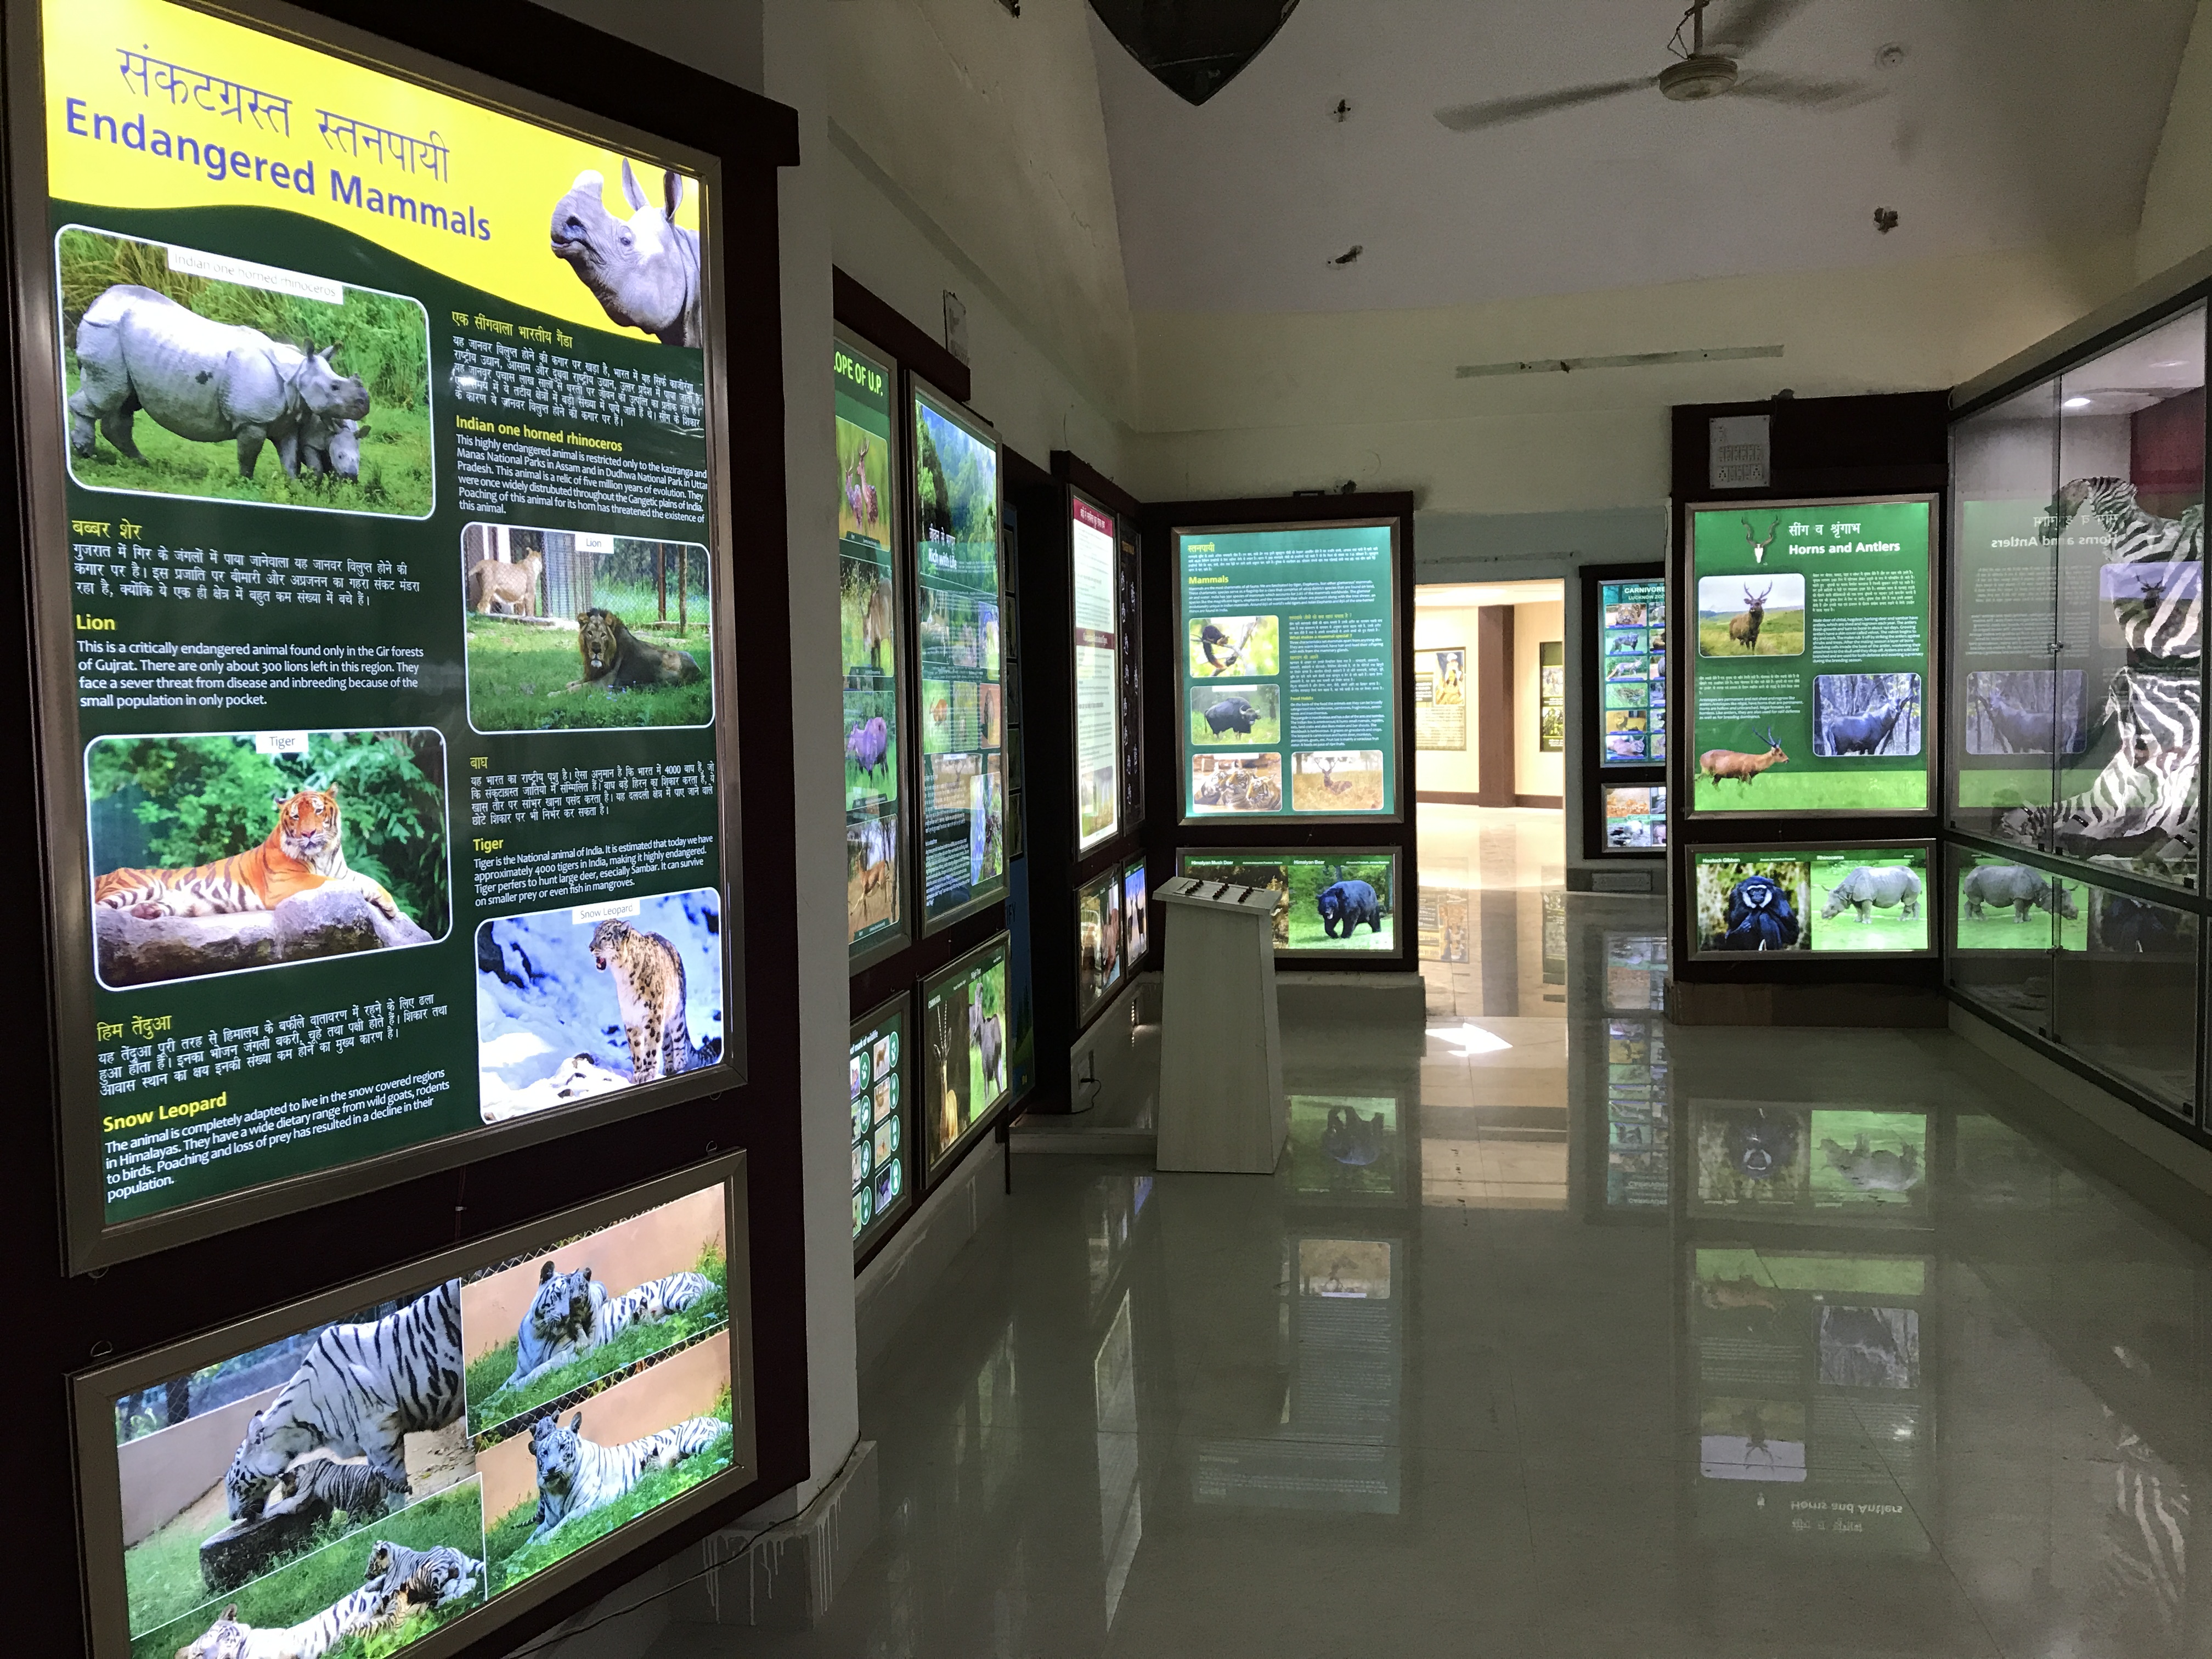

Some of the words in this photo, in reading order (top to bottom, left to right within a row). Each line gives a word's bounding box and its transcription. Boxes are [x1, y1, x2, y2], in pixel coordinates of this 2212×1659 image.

[116, 44, 292, 138] संकटग्रस्त
[315, 109, 450, 183] स्तनपायी
[66, 97, 315, 195] Endangered
[331, 169, 492, 241] Mammals
[175, 253, 210, 270] Indian
[213, 263, 234, 275] one
[281, 276, 336, 297] rhinoceros
[452, 311, 469, 327] एक
[475, 314, 514, 336] सींगवाला
[518, 325, 552, 344] भारतीय
[556, 328, 573, 348] गैंडा
[834, 351, 854, 380] OPE
[855, 363, 866, 386] OF
[868, 370, 883, 396] U.P.
[456, 415, 495, 433] Indian
[498, 422, 520, 437] one
[523, 425, 563, 444] horned
[567, 432, 623, 452] rhinoceros
[456, 433, 473, 446] This
[475, 436, 501, 452] highly
[502, 442, 551, 457] endangered
[552, 448, 578, 460] animal
[578, 451, 585, 461] is
[586, 454, 622, 467] restricted
[622, 459, 639, 471] only
[639, 460, 647, 470] to
[648, 461, 661, 472] the
[661, 462, 693, 479] kaziranga
[694, 469, 707, 479] and
[72, 520, 110, 538] बब्बर
[119, 518, 142, 540] शेर
[1788, 522, 1809, 536] सींग
[1815, 524, 1824, 535] व
[586, 538, 602, 548] Lion
[1188, 542, 1215, 552] स्तनपायी
[1789, 545, 1825, 555] Horns
[1829, 542, 1852, 553] and
[1855, 541, 1900, 552] Antlers
[72, 543, 112, 561] गुजरात
[117, 543, 127, 558] में
[131, 544, 153, 560] गिर
[157, 545, 169, 561] के
[173, 548, 204, 563] जंगलों
[208, 549, 218, 564] में
[223, 554, 245, 566] पाया
[249, 552, 290, 568] जानेवाला
[294, 558, 308, 570] यह
[312, 559, 343, 572] जानवर
[347, 558, 373, 577] विलुप्त
[376, 560, 393, 574] होने
[396, 561, 408, 575] की
[928, 548, 939, 563] Rich
[1188, 575, 1229, 584] Mammals
[76, 614, 116, 631] Lion
[76, 640, 104, 653] This
[106, 640, 116, 653] is
[118, 644, 127, 653] a
[128, 641, 178, 657] critically
[180, 642, 250, 658] endangered
[252, 644, 288, 656] animal
[289, 644, 321, 656] found
[323, 645, 345, 659] only
[346, 645, 356, 656] in
[357, 645, 374, 657] the
[376, 646, 390, 657] Gir
[391, 645, 424, 657] forests
[268, 736, 296, 749] Tiger
[470, 756, 488, 769] बाघ
[473, 838, 504, 854] Tiger
[473, 858, 495, 871] Tiger
[495, 856, 503, 866] is
[503, 855, 516, 865] the
[517, 850, 550, 864] National
[551, 848, 575, 860] animal
[576, 847, 585, 857] of
[585, 845, 605, 856] India.
[605, 845, 611, 854] It
[612, 844, 618, 853] is
[618, 840, 652, 853] estimated
[653, 839, 668, 849] that
[667, 837, 687, 848] today
[698, 835, 713, 844] have
[580, 910, 601, 920] Snow
[603, 904, 633, 917] Leopard
[97, 1020, 123, 1042] हिम
[131, 1014, 172, 1040] तेंदुआ
[103, 1111, 154, 1133] Snow
[159, 1092, 228, 1121] Leopard
[104, 1140, 128, 1154] The
[130, 1128, 169, 1148] animal
[170, 1127, 180, 1139] is
[182, 1113, 243, 1136] completely
[244, 1102, 287, 1122] adapted
[289, 1102, 300, 1112] to
[301, 1098, 318, 1109] live
[319, 1094, 329, 1105] in
[330, 1091, 347, 1103] the
[348, 1085, 374, 1099] snow
[375, 1075, 411, 1092] covered
[413, 1069, 445, 1085] regions
[108, 1176, 174, 1203] population.
